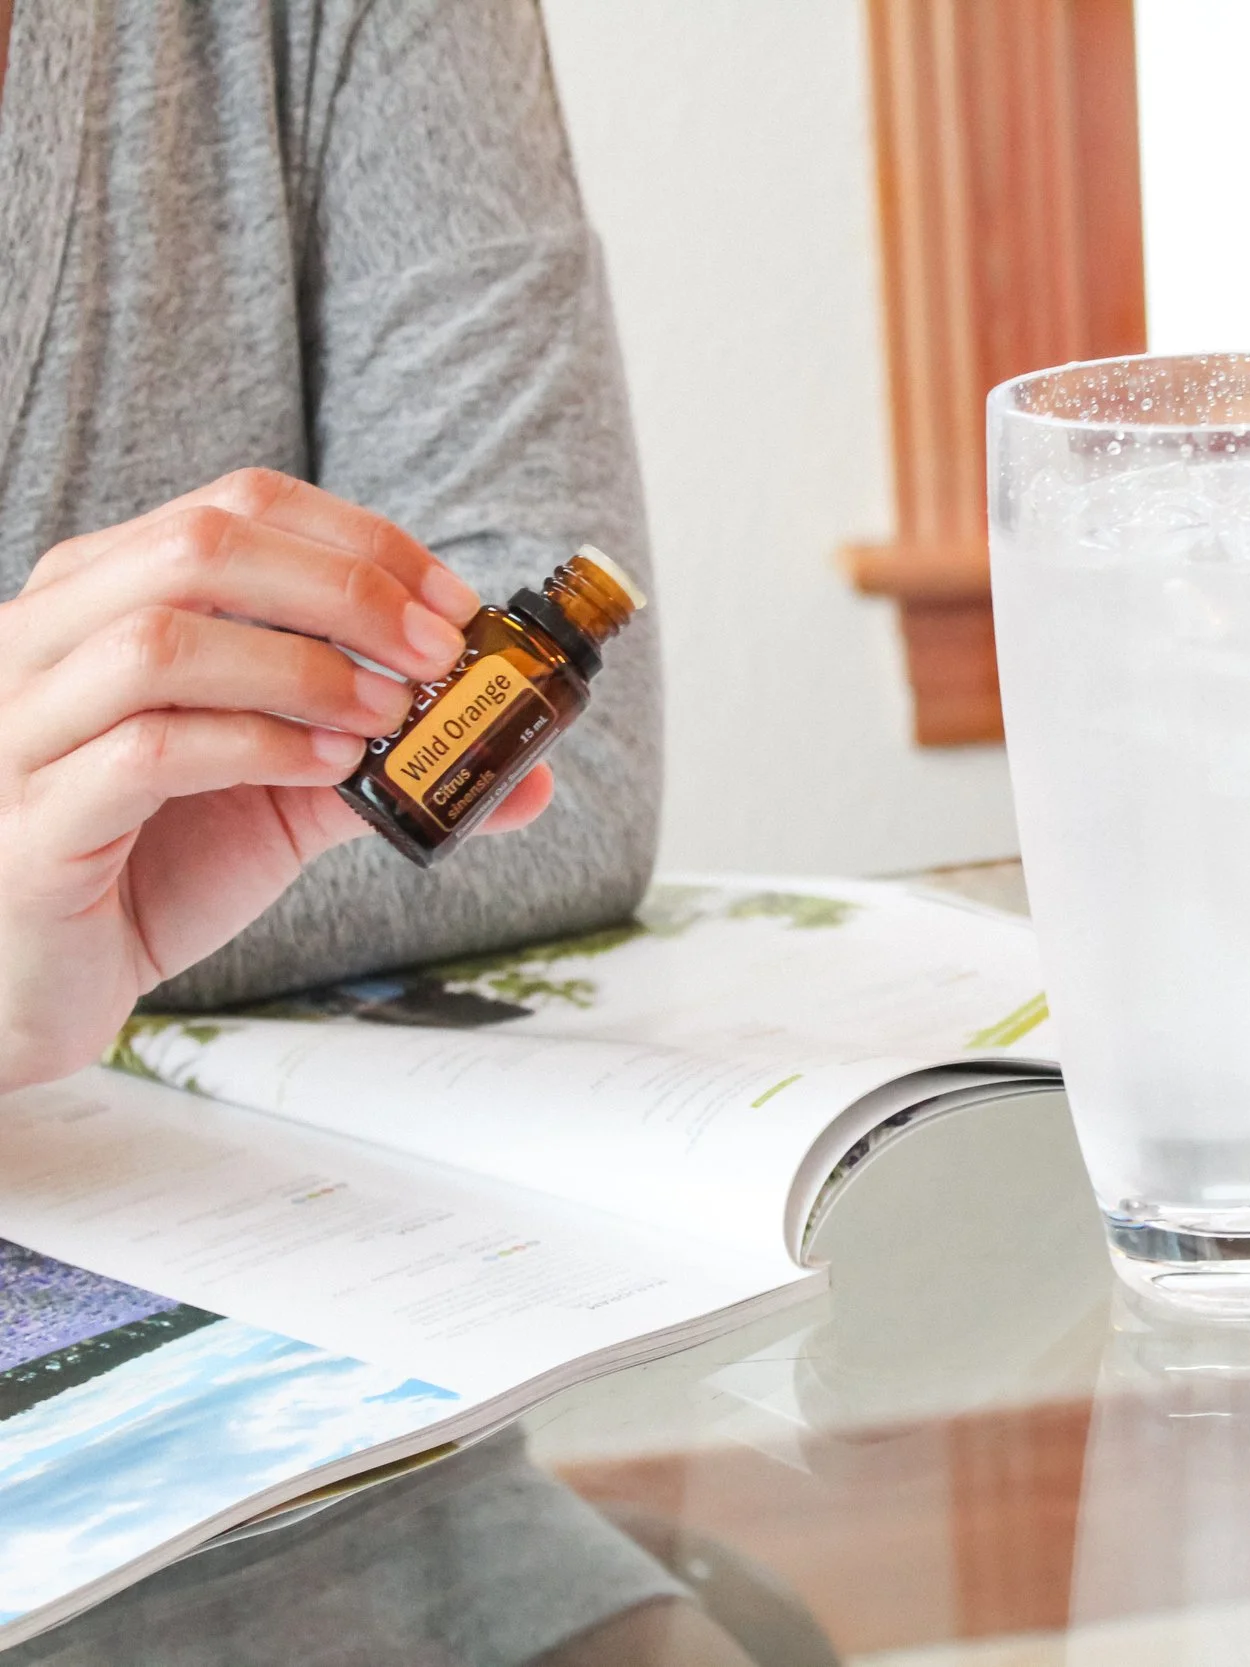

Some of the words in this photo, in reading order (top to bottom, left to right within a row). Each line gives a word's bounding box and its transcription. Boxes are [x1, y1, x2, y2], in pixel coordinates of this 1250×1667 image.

[401, 735, 450, 781] Wild
[443, 674, 511, 740] Orange
[520, 728, 535, 744] 15
[432, 768, 471, 806] Citrus
[448, 770, 496, 820] sinensis
